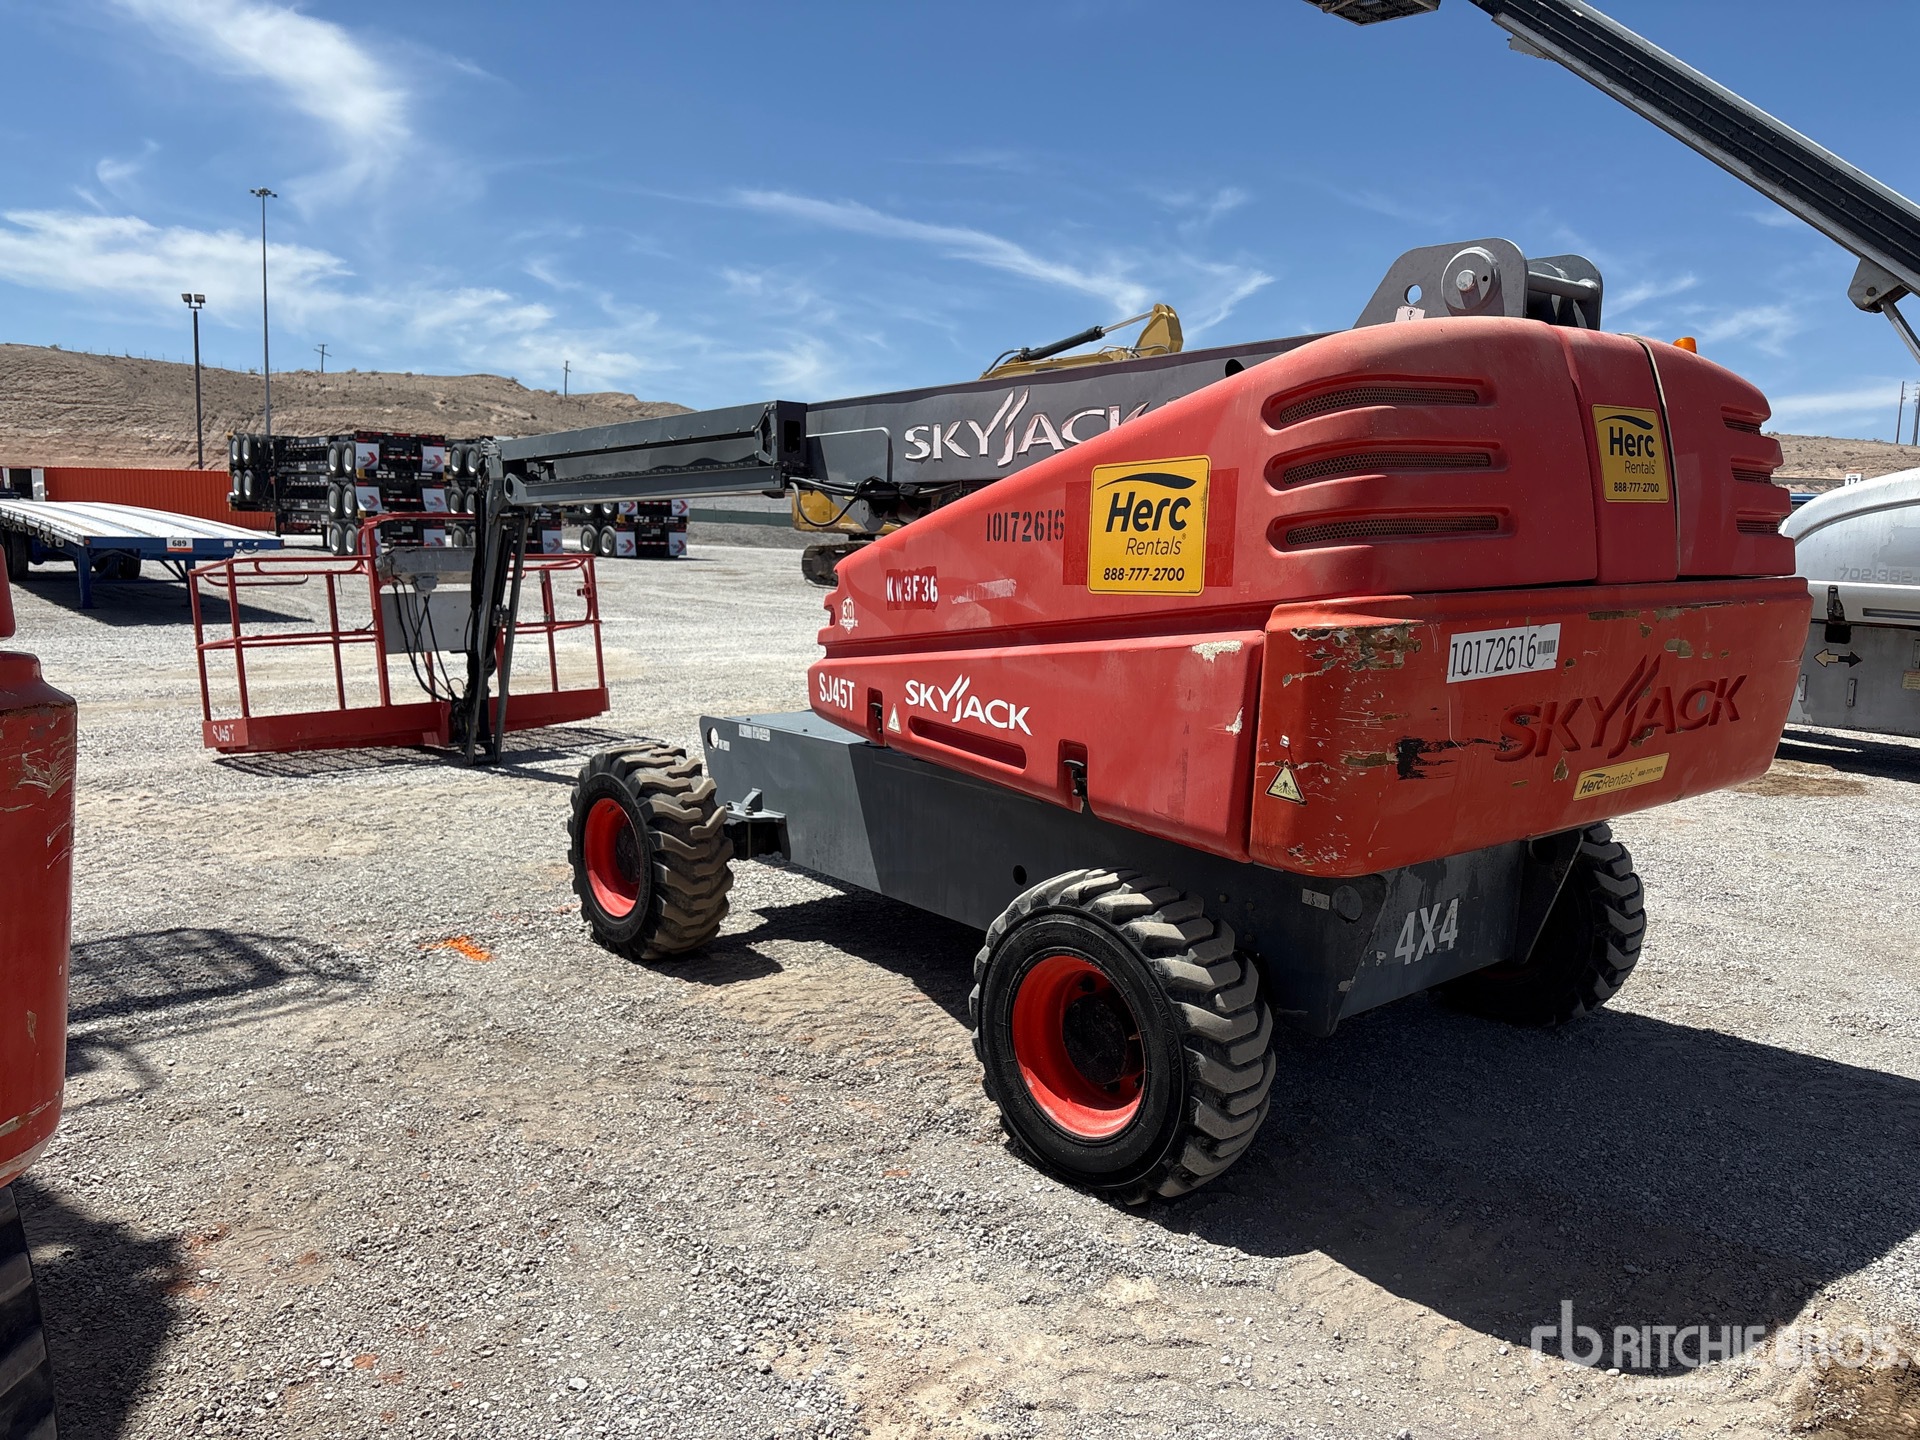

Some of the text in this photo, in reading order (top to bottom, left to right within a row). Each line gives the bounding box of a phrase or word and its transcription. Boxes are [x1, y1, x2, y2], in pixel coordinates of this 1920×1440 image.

[1610, 426, 1655, 458] Herc
[1615, 482, 1659, 493] 888-777-2700
[986, 509, 1065, 542] 10172616
[1106, 491, 1191, 533] Herc
[1103, 567, 1185, 583] 888-777-2700
[1451, 634, 1537, 677] 10172616
[819, 671, 855, 712] SJ45T
[905, 673, 1033, 735] SKYJACK
[1495, 653, 1747, 762] SKYJACK
